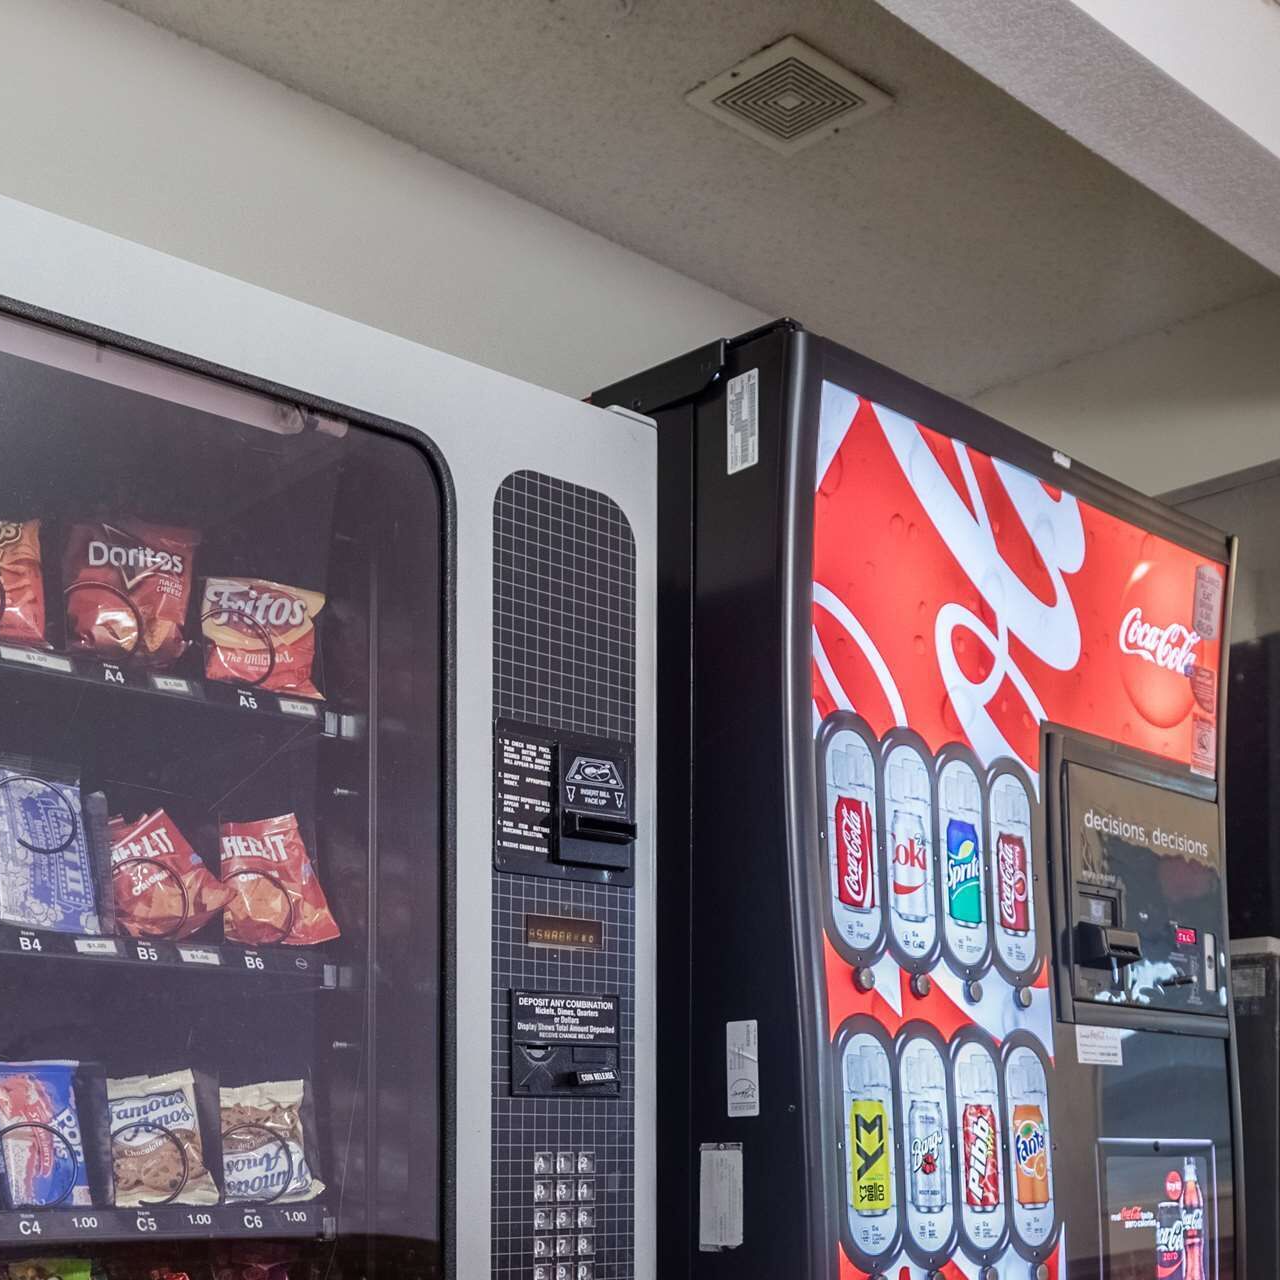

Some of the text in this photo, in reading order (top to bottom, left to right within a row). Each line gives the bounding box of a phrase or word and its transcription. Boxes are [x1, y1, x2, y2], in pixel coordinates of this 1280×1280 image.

[88, 541, 184, 574] Doritos
[206, 586, 307, 625] Fritos
[1119, 607, 1200, 675] Coca-Cola
[105, 669, 125, 684] A4
[239, 695, 258, 709] A5
[585, 796, 598, 804] FACE
[599, 790, 610, 798] BILL
[1084, 809, 1208, 857] decisions, decisions
[841, 803, 864, 902] Coca-Cola
[20, 937, 42, 952] B4
[137, 946, 158, 962] B5
[244, 956, 265, 970] B6
[519, 997, 613, 1010] DEPOSIT ANY COMBINATION
[535, 1007, 599, 1018] Nickels, Dimes, Quarters
[561, 1016, 580, 1025] Dollars
[517, 1022, 615, 1035] Display Shows Total Amount Deposited
[581, 1071, 615, 1082] COIN RELEASE
[110, 1092, 184, 1121] Famous
[967, 1115, 993, 1202] Pibb
[860, 1183, 884, 1194] Mello
[72, 1216, 98, 1229] 1.00
[187, 1213, 212, 1226] 1.00
[244, 1215, 263, 1229] C6
[284, 1210, 307, 1223] 1.00
[20, 1221, 42, 1235] C4
[137, 1218, 157, 1232] C5
[1163, 1252, 1178, 1261] zero
